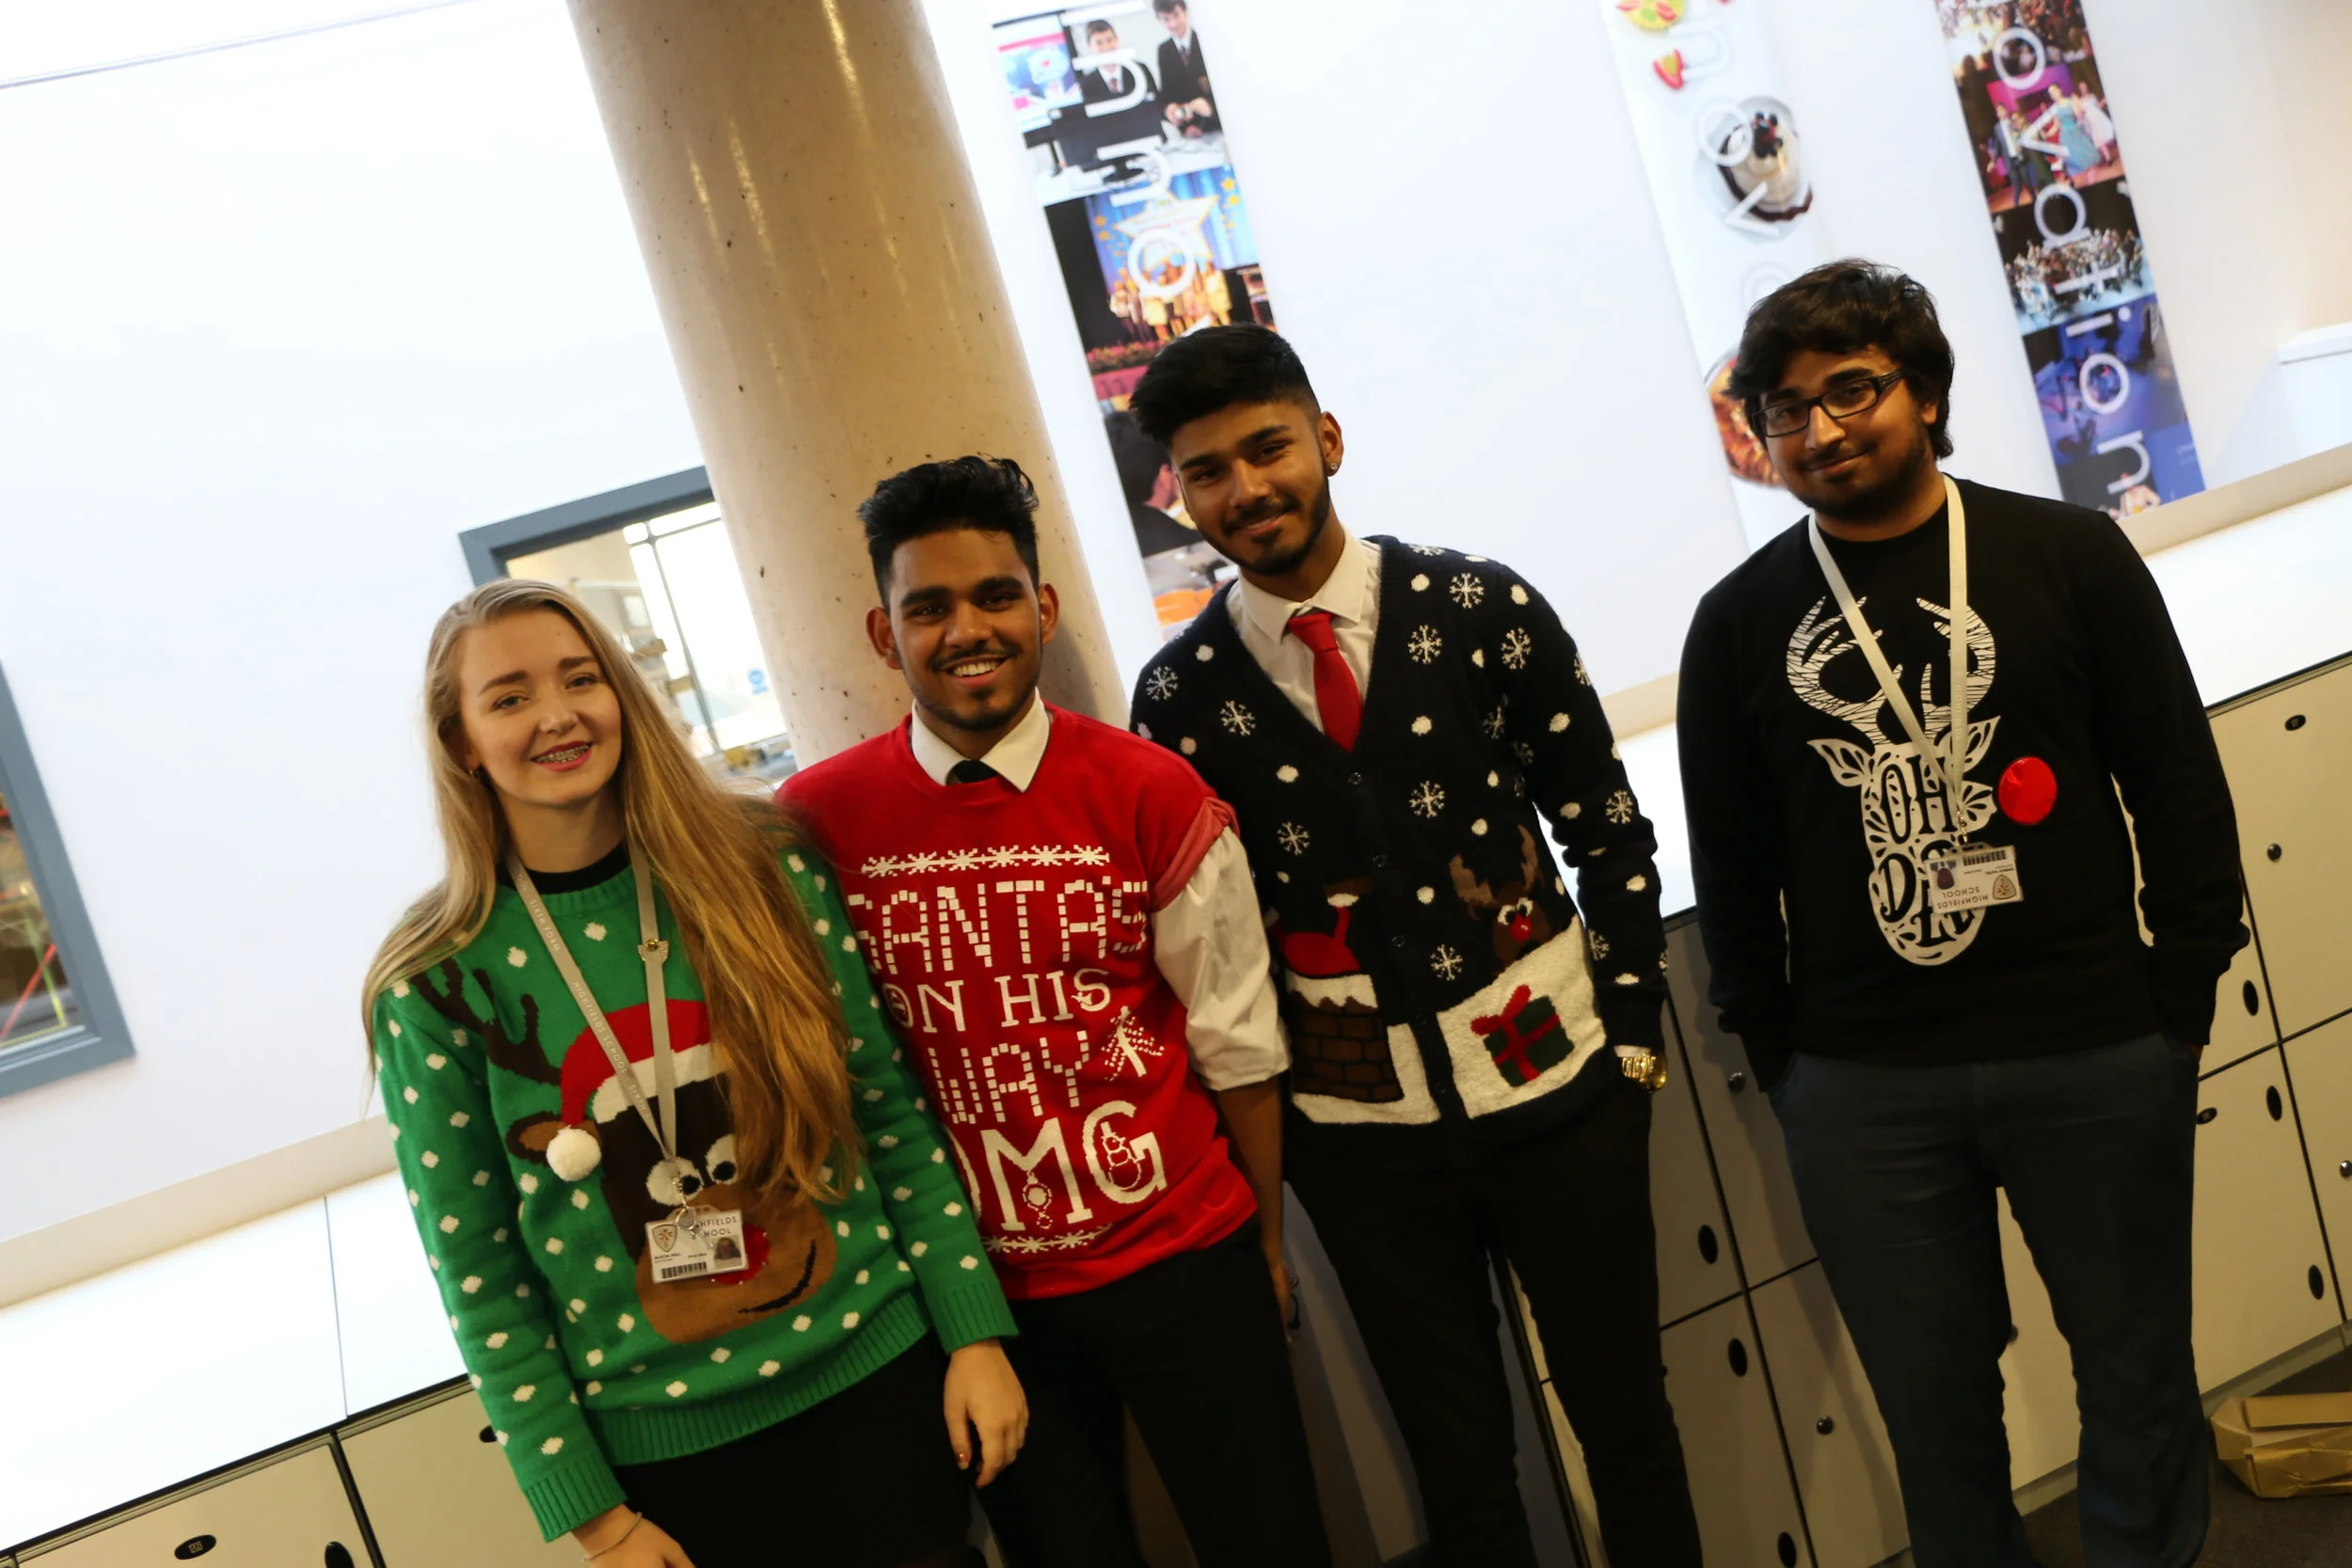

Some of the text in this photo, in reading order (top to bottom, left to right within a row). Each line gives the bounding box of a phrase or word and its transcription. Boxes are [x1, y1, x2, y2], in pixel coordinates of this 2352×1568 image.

[1974, 0, 2151, 495] ovation
[1880, 754, 1959, 845] OH
[1936, 894, 1989, 910] HIGHFIELDS
[1942, 886, 1980, 898] SCHOOL
[573, 981, 607, 1034] HIGHFIELDS
[603, 1035, 628, 1074] SCHOOL
[882, 968, 1110, 1033] ON HIS
[928, 1030, 1089, 1125] WAY
[691, 1227, 732, 1240] HOOL
[698, 1215, 738, 1228] HFIELDS
